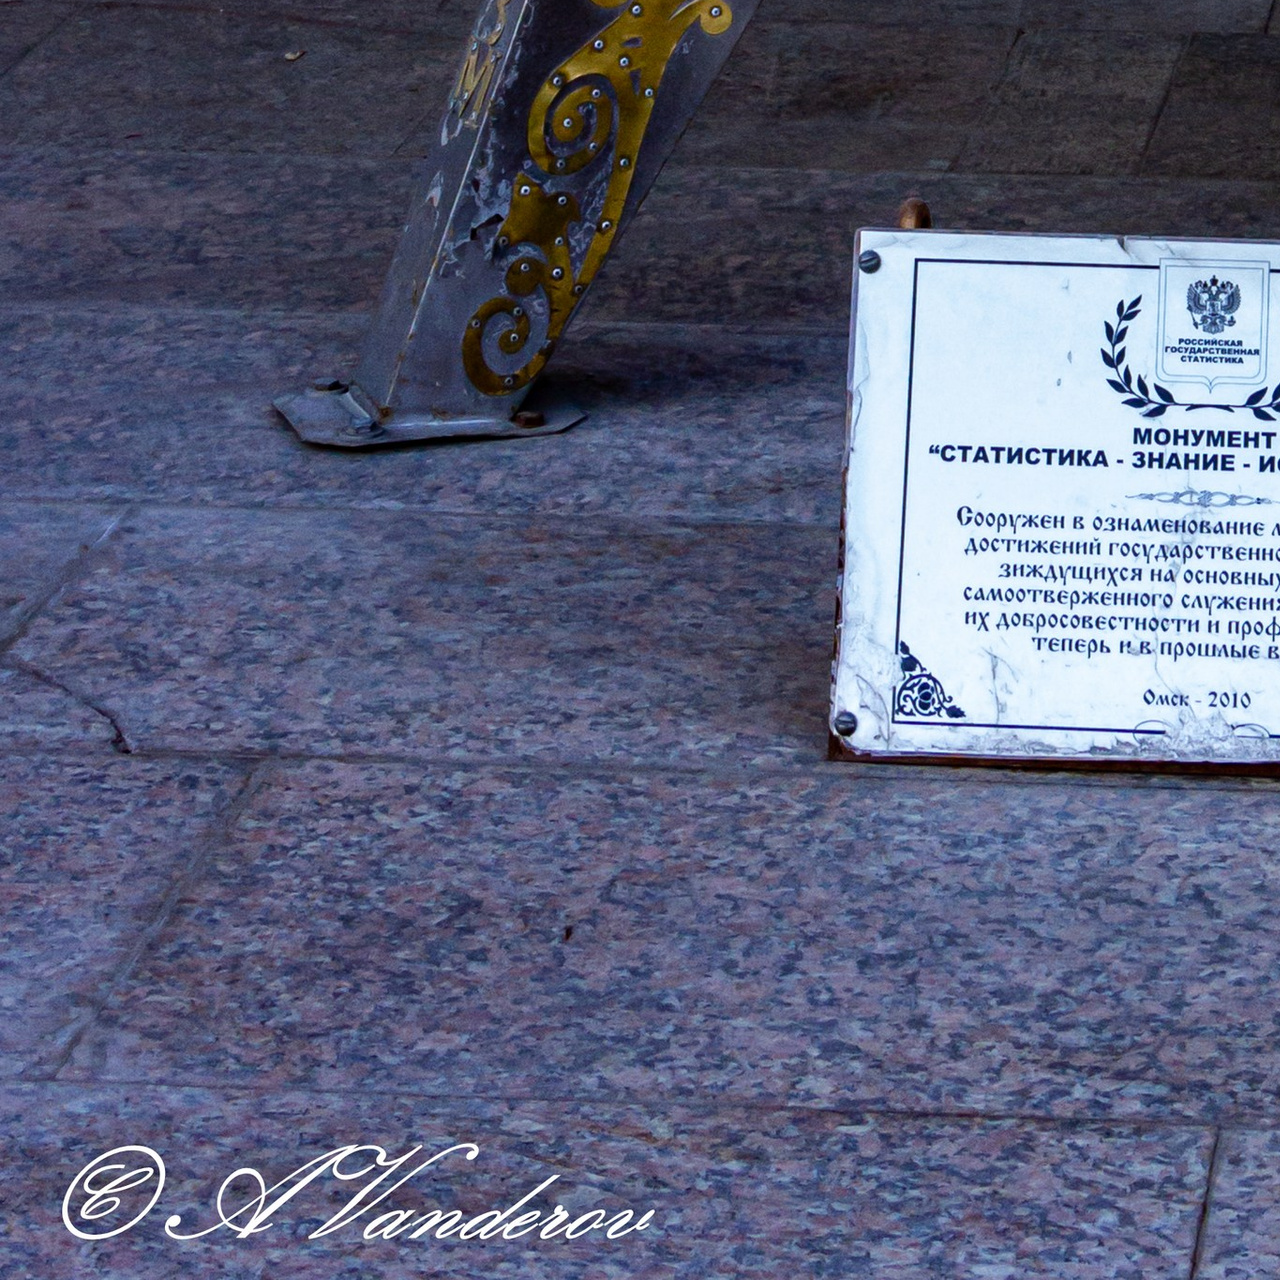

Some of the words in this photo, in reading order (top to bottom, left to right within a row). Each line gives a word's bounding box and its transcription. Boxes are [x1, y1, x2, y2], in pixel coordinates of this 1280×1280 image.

[1165, 346, 1260, 356] ГОСУДАРСТВЕННАЯ
[1178, 337, 1243, 347] РОССИЙСКАЯ
[1180, 355, 1244, 364] СТАТИСТИКА
[1132, 427, 1277, 449] МОНУМЕНТ
[1131, 451, 1235, 472] ЗНАНИЕ
[956, 505, 1066, 534] Сооружен
[1072, 515, 1085, 530] в
[1092, 516, 1265, 536] ознаменование
[964, 537, 1101, 556] достижений
[998, 562, 1142, 587] зиждущихся
[1150, 567, 1176, 583] на
[963, 586, 1173, 610] самоотверженного
[964, 610, 990, 632] их
[996, 610, 1200, 634] добросовестности
[1207, 620, 1220, 634] и
[1031, 635, 1111, 659] теперь
[1119, 640, 1131, 654] и
[1139, 639, 1152, 654] в
[1160, 639, 1260, 662] прошлые
[1143, 688, 1189, 706] Омск
[1208, 691, 1251, 708] 2010
